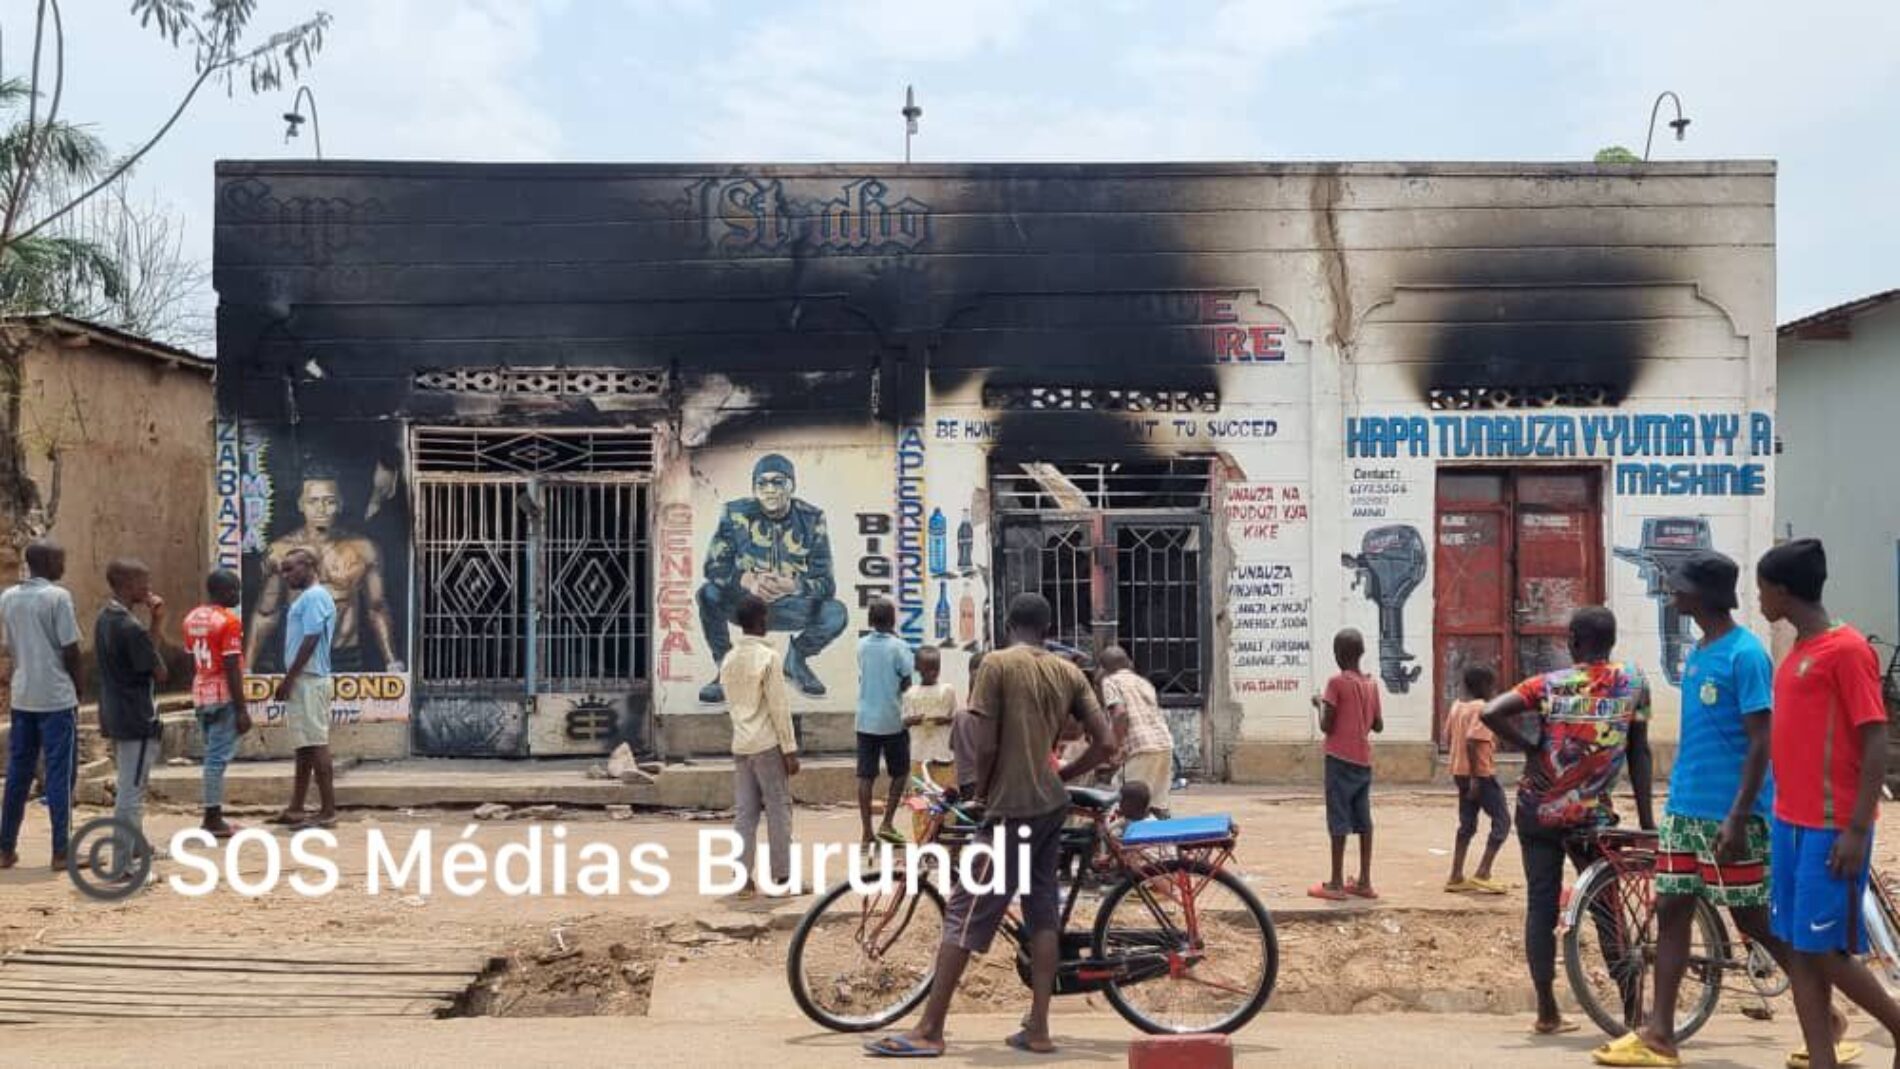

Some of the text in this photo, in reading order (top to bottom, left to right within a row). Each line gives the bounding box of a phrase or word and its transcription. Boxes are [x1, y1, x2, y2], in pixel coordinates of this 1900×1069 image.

[936, 420, 958, 438] BE
[1172, 420, 1196, 438] TO
[1207, 420, 1278, 437] SUCCED
[1346, 416, 1429, 458] HAPA
[1433, 415, 1577, 458] TUNAUZA
[1580, 413, 1694, 458] VYUMA
[1616, 463, 1766, 497] MASHINE
[1282, 486, 1301, 501] NA
[1244, 523, 1279, 539] KIKE
[657, 503, 694, 682] GENERAL
[243, 675, 405, 701] DIOND
